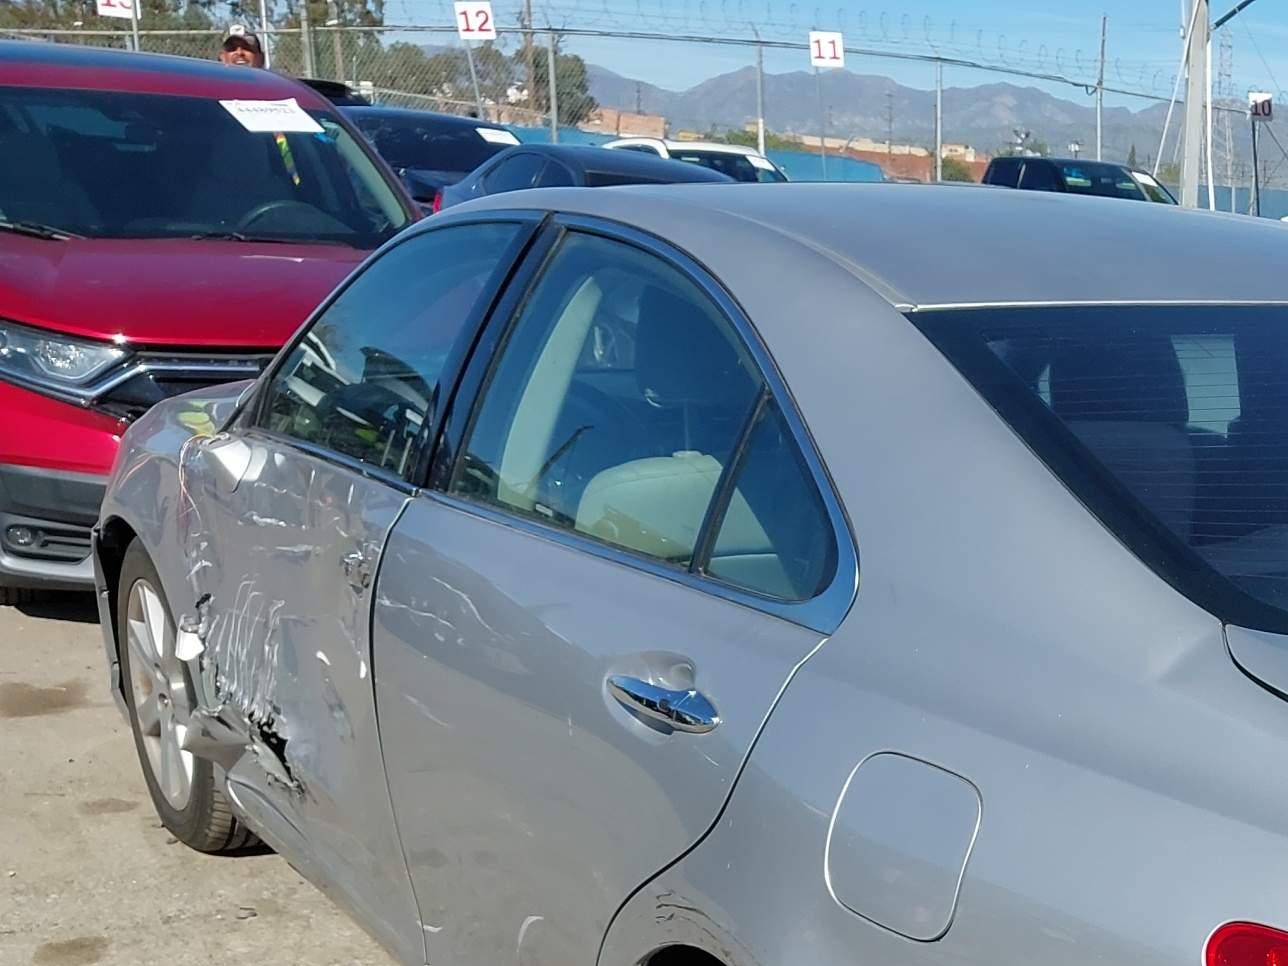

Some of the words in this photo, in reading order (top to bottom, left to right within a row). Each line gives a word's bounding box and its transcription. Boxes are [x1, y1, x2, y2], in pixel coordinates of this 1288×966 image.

[459, 10, 492, 32] 12
[812, 40, 841, 60] 11
[1251, 100, 1272, 117] 10
